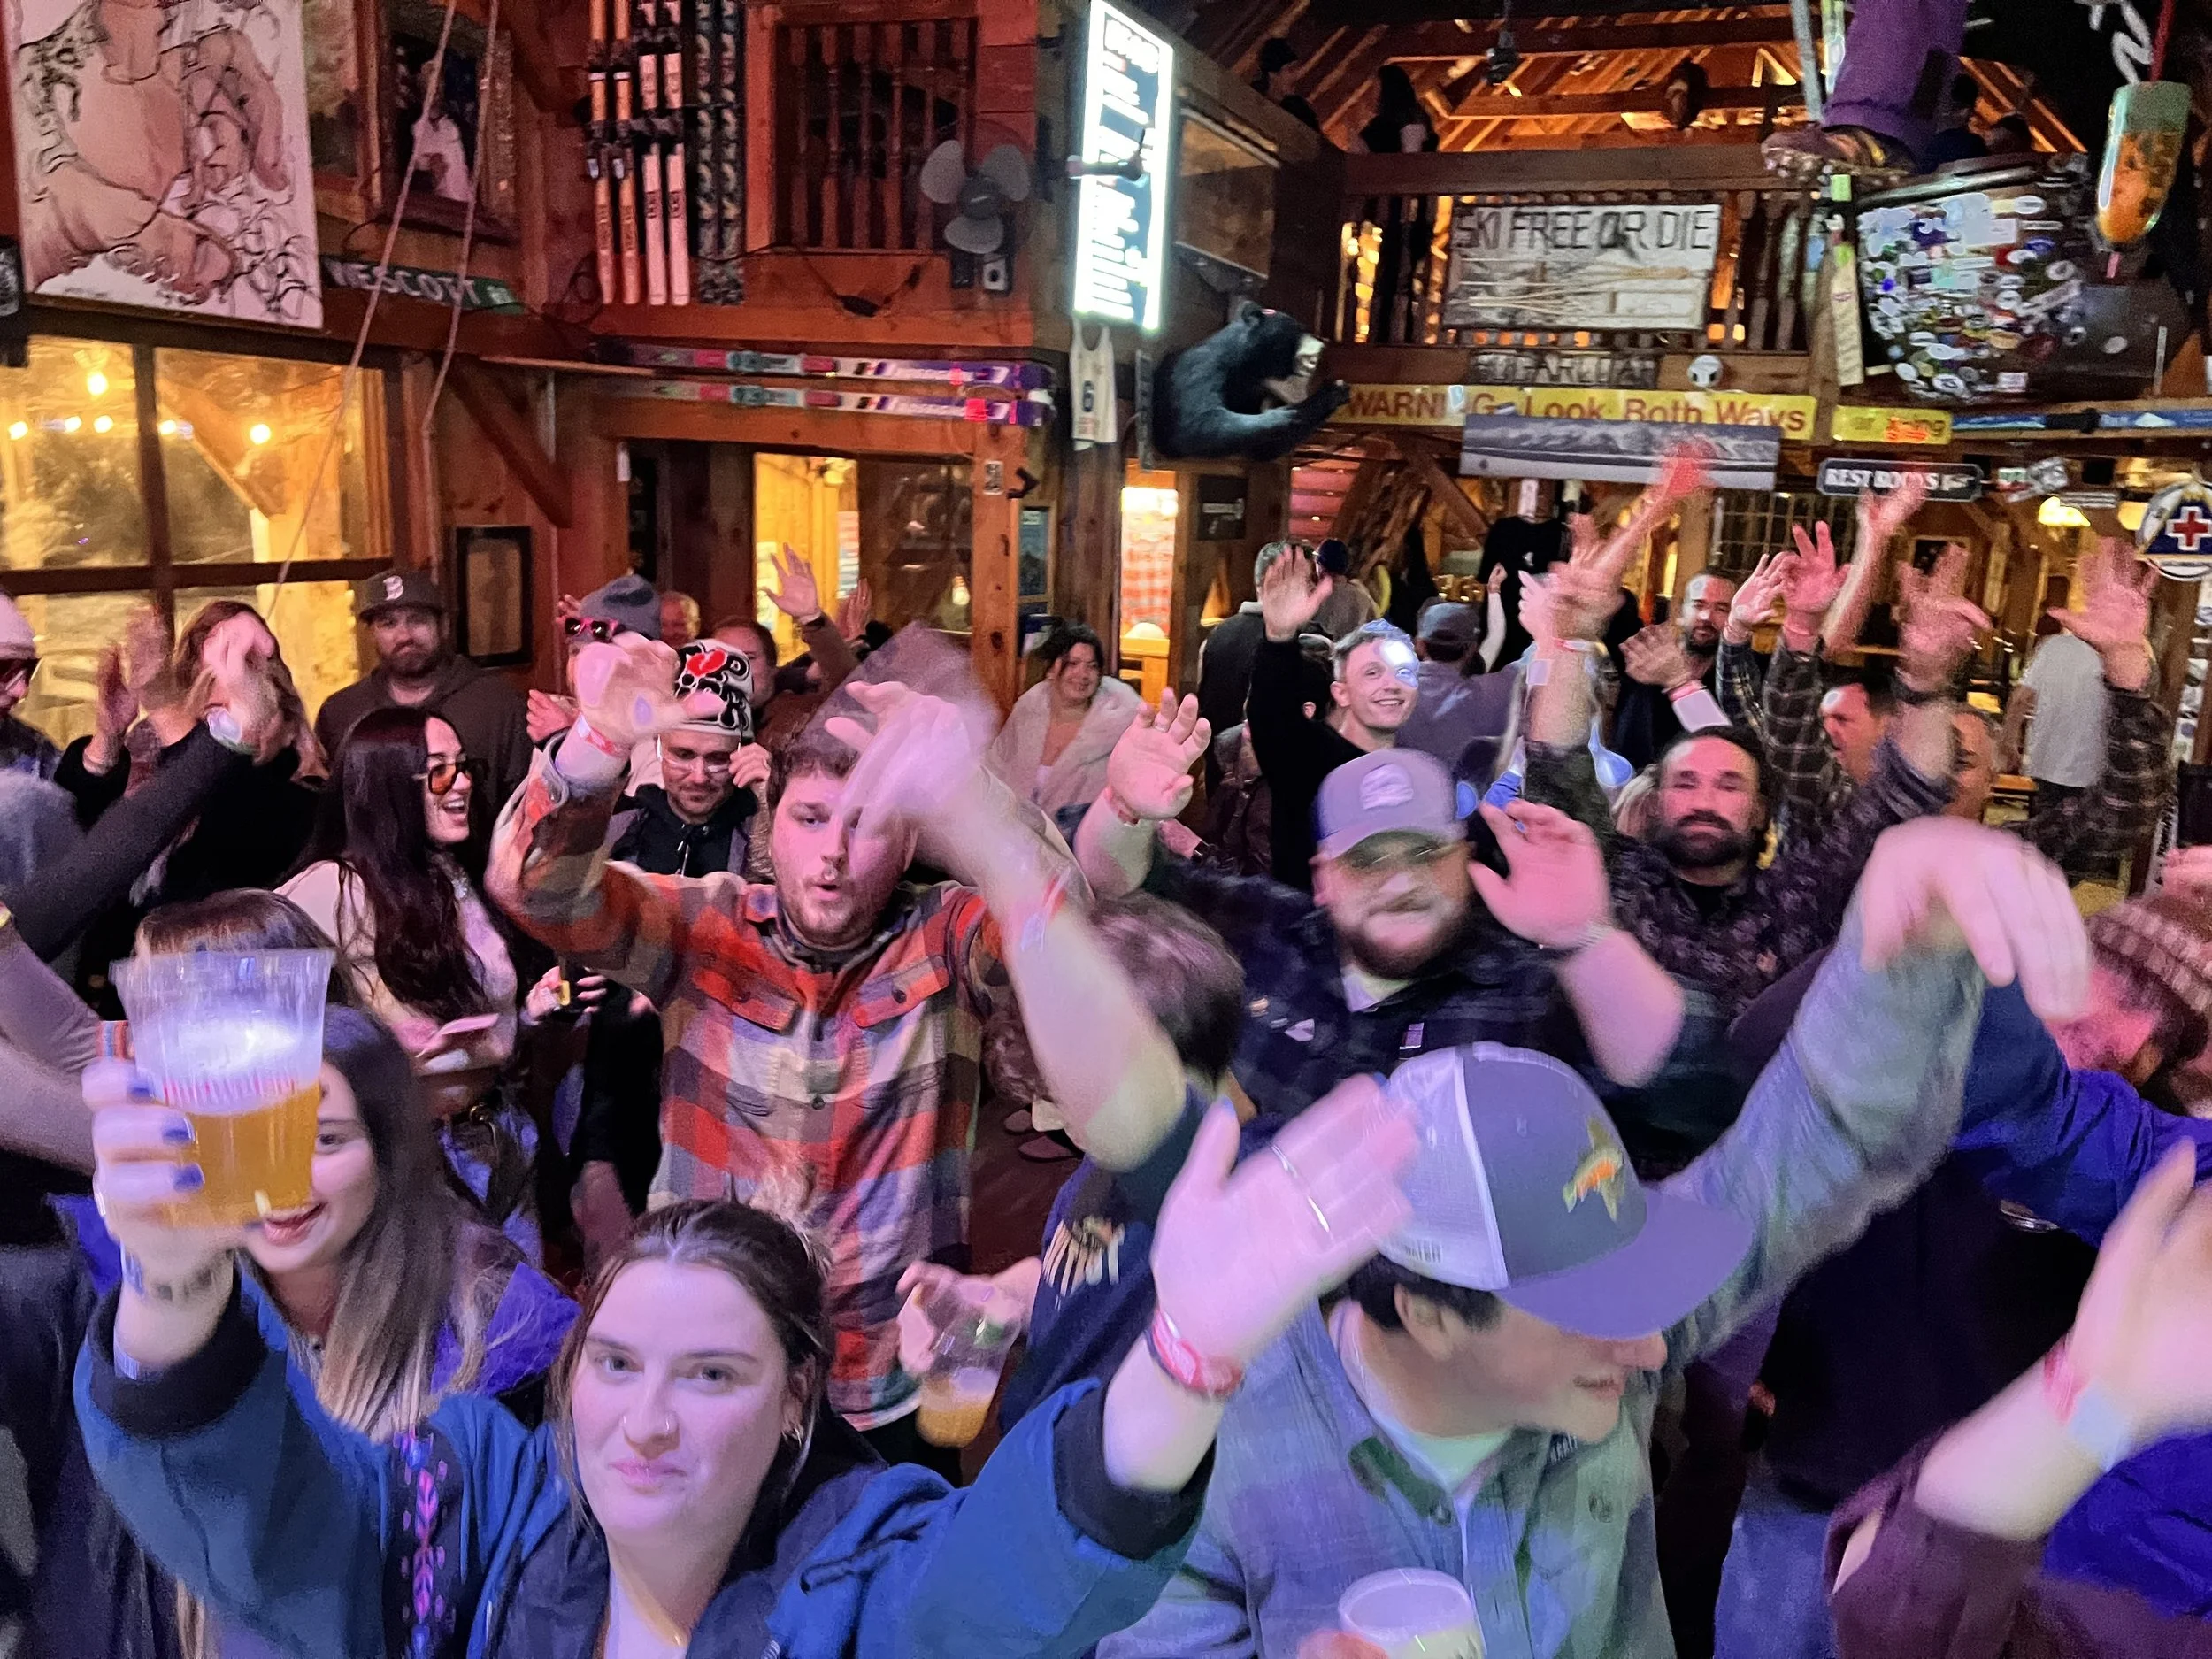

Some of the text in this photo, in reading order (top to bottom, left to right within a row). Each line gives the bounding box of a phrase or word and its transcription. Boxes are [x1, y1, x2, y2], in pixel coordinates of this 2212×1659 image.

[1455, 209, 1717, 253] SKI FREE OR DIE
[1624, 397, 1703, 424] Both
